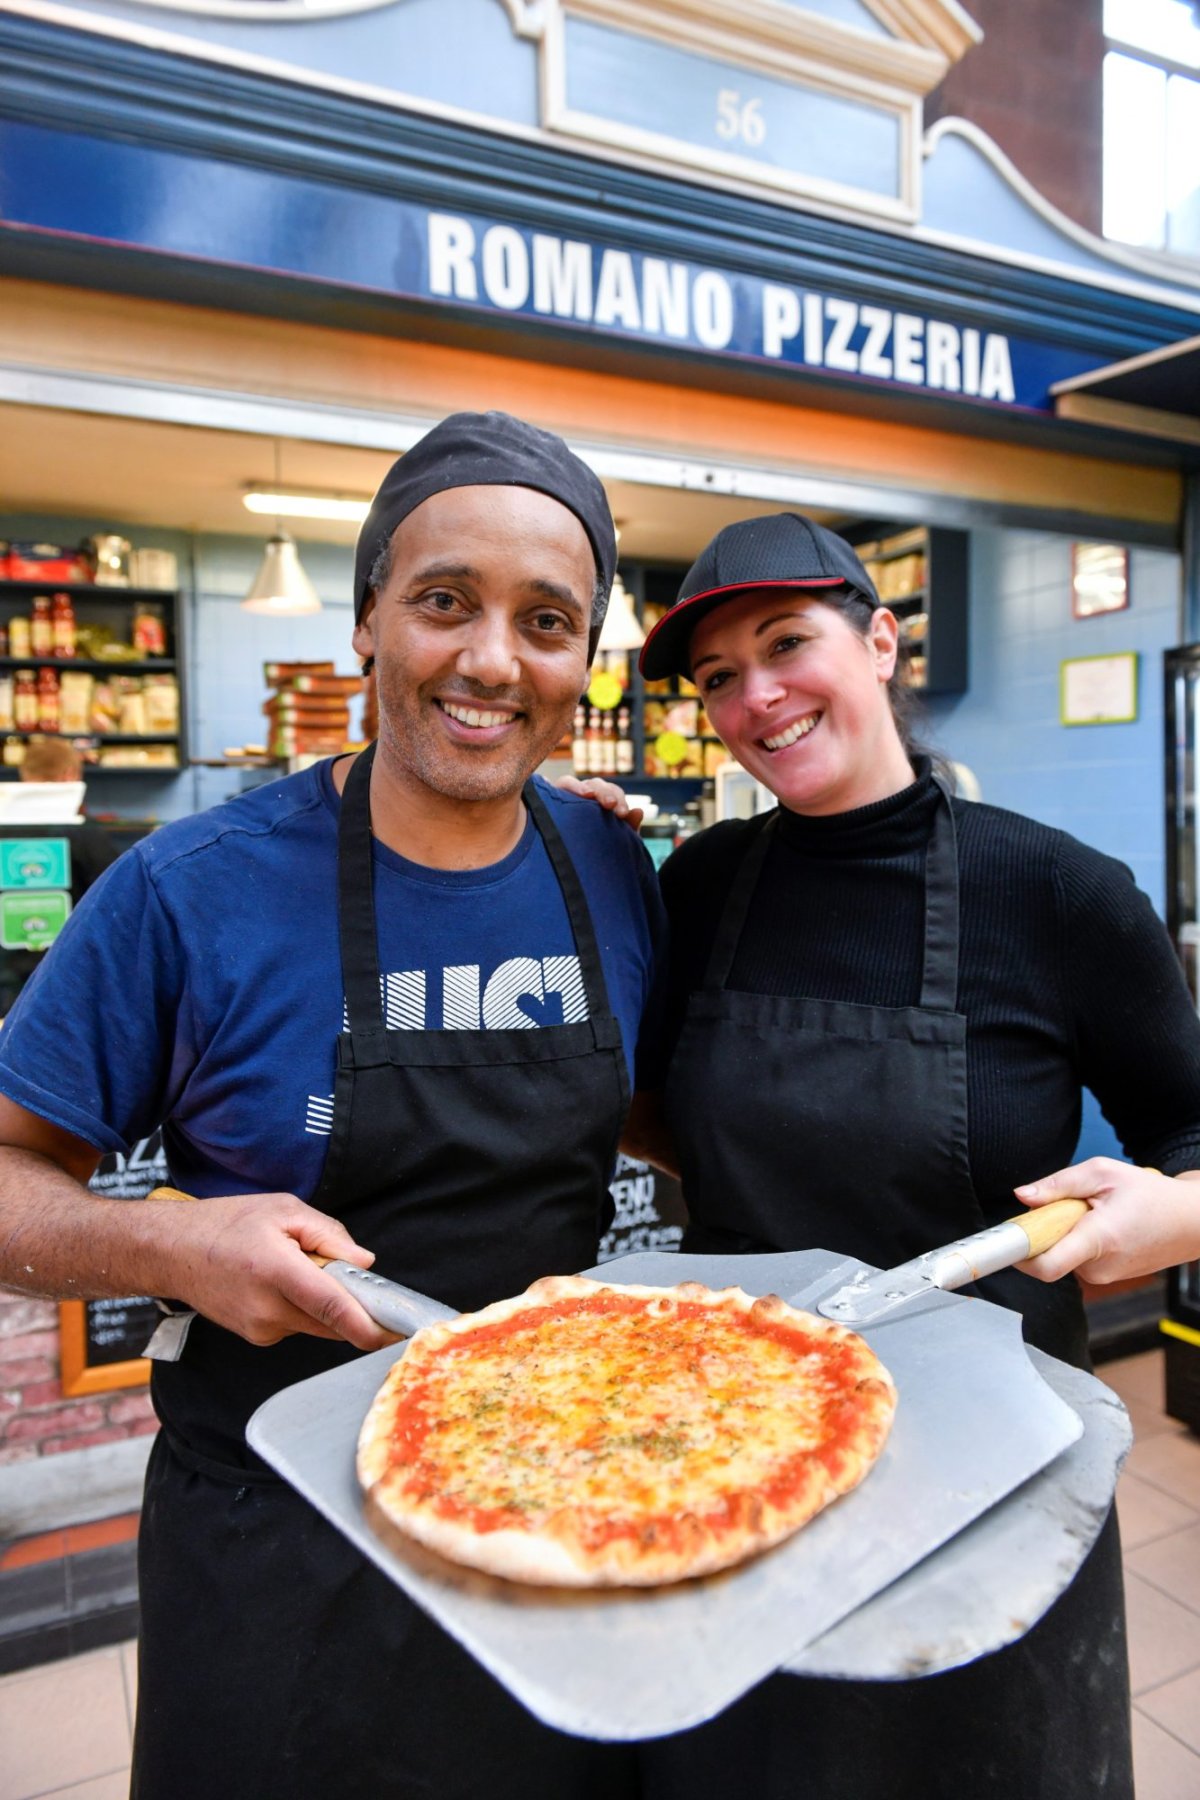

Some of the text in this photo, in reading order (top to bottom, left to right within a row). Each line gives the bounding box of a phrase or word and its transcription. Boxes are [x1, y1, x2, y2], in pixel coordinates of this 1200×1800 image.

[715, 89, 766, 146] 56
[427, 212, 1016, 402] ROMANO PIZZERIA
[608, 1174, 655, 1213] ENU
